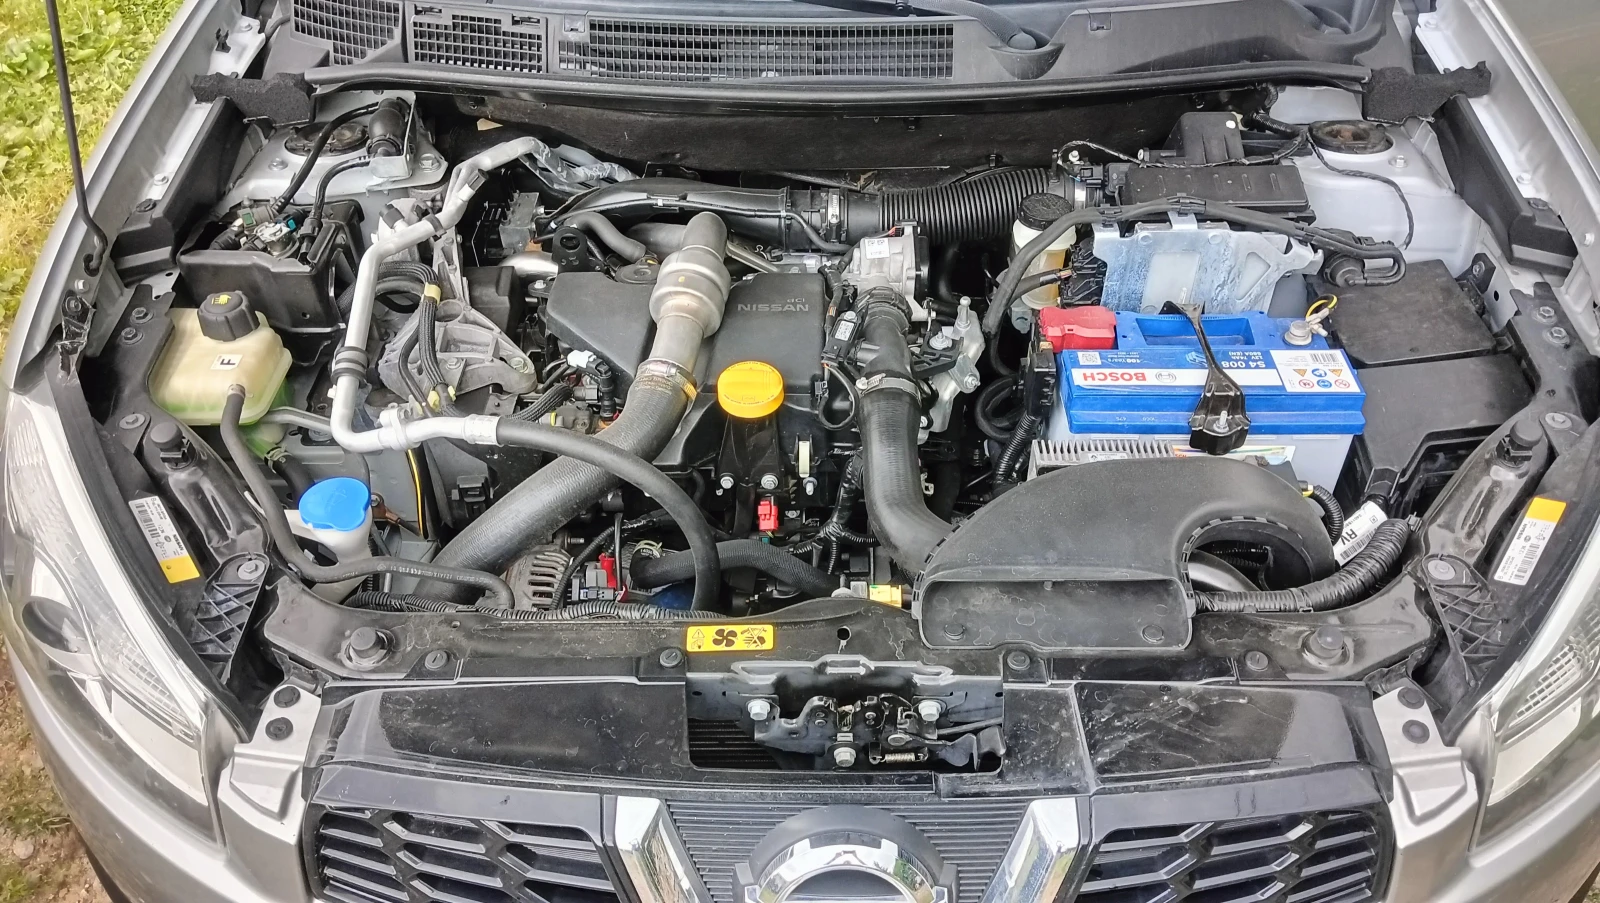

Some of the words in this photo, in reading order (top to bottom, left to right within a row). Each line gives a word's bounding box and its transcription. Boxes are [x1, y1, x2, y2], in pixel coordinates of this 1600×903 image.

[737, 303, 809, 312] NISSAN
[220, 358, 236, 366] F
[1221, 360, 1246, 368] 008
[1248, 360, 1266, 368] S4
[1082, 372, 1147, 382] BOSCH
[1340, 528, 1358, 545] RV
[1516, 523, 1528, 541] NISSAN
[172, 533, 184, 551] NISSAN
